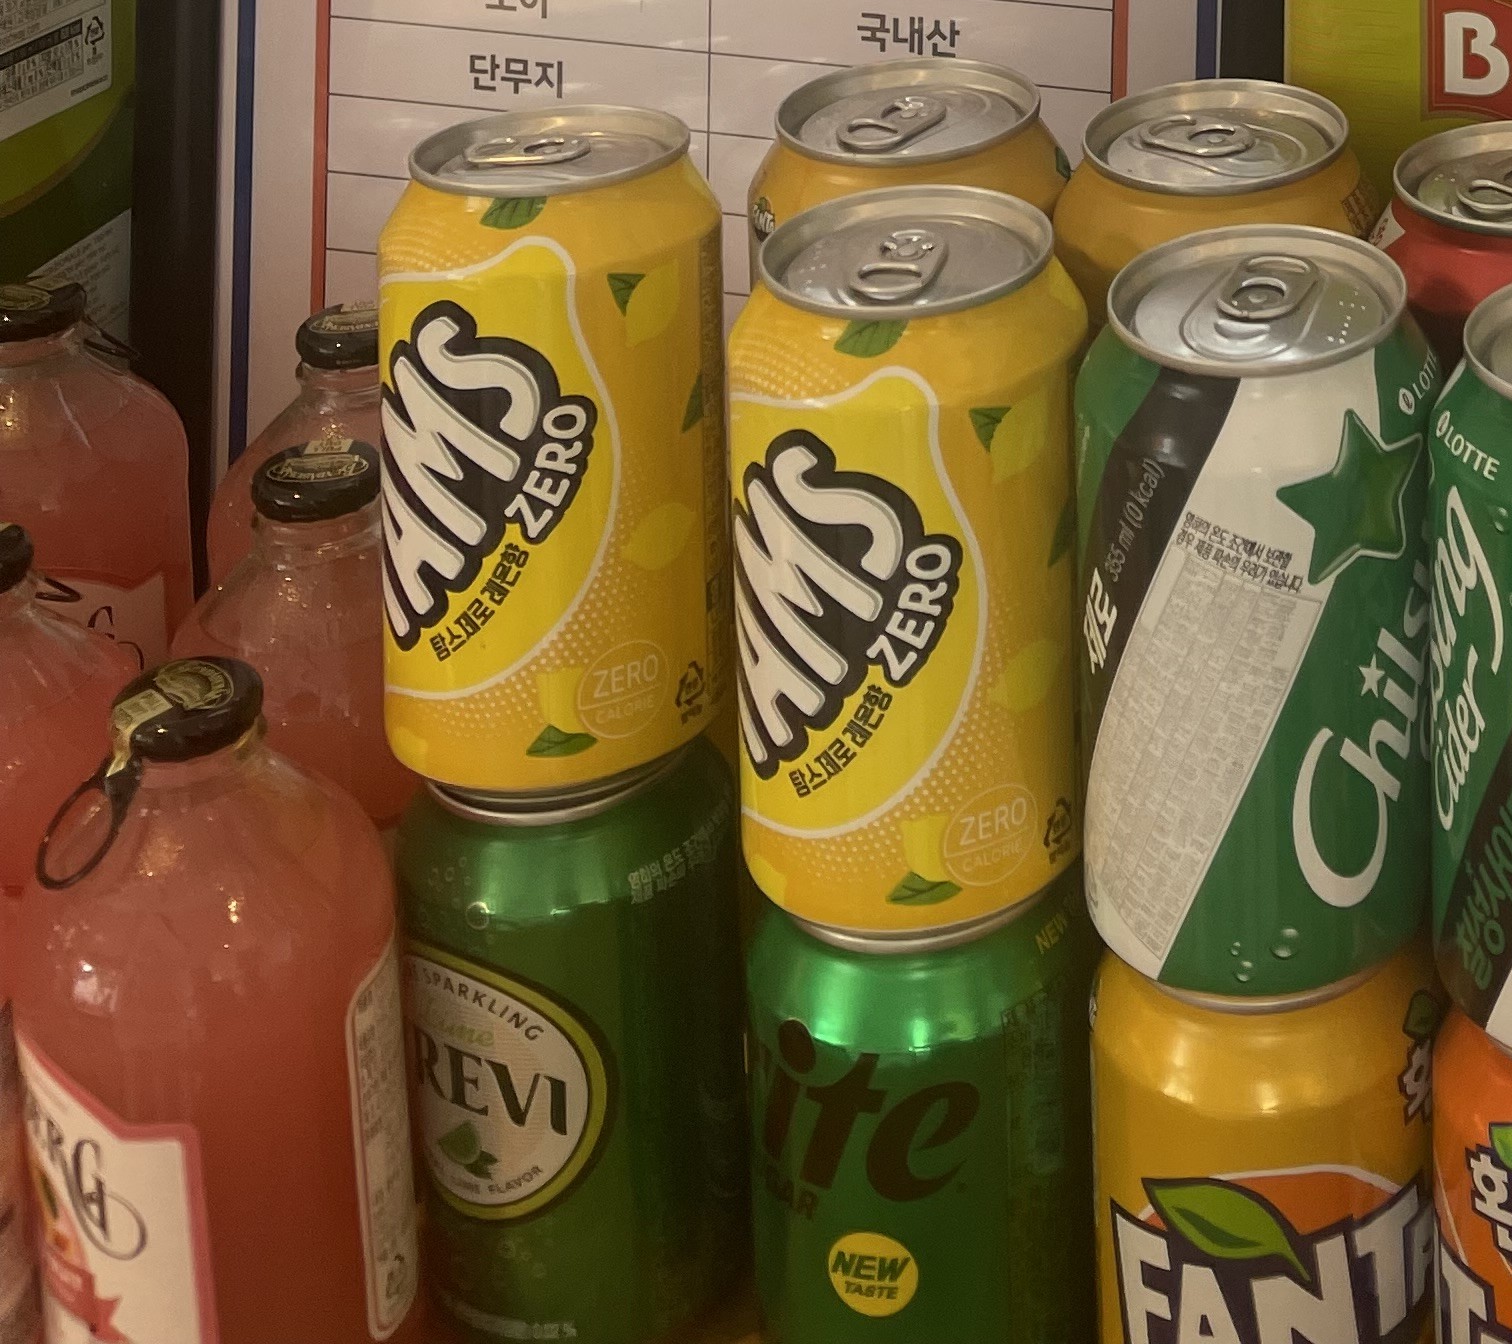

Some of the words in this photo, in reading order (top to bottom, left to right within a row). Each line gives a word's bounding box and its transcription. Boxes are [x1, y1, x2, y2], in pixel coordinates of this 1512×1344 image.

[857, 12, 961, 59] 국내산
[469, 54, 565, 99] 단무지
[1412, 344, 1438, 400] LOTT
[505, 402, 588, 540] ZERO
[1443, 426, 1500, 482] LOTTE
[430, 598, 493, 661] 탐스제로
[484, 542, 530, 606] 레몬향
[868, 543, 953, 682] ZERO
[591, 654, 660, 700] ZERO
[788, 738, 858, 799] 탐스제로
[847, 682, 893, 748] 레몬향
[1292, 540, 1428, 909] Chils
[959, 798, 1027, 848] ZERO
[422, 966, 544, 1042] SPARKLING
[413, 1026, 568, 1137] REVI
[758, 1018, 981, 1203] ite
[830, 1249, 911, 1284] NEW
[843, 1279, 899, 1301] TASTE
[1114, 1184, 1433, 1344] FANT
